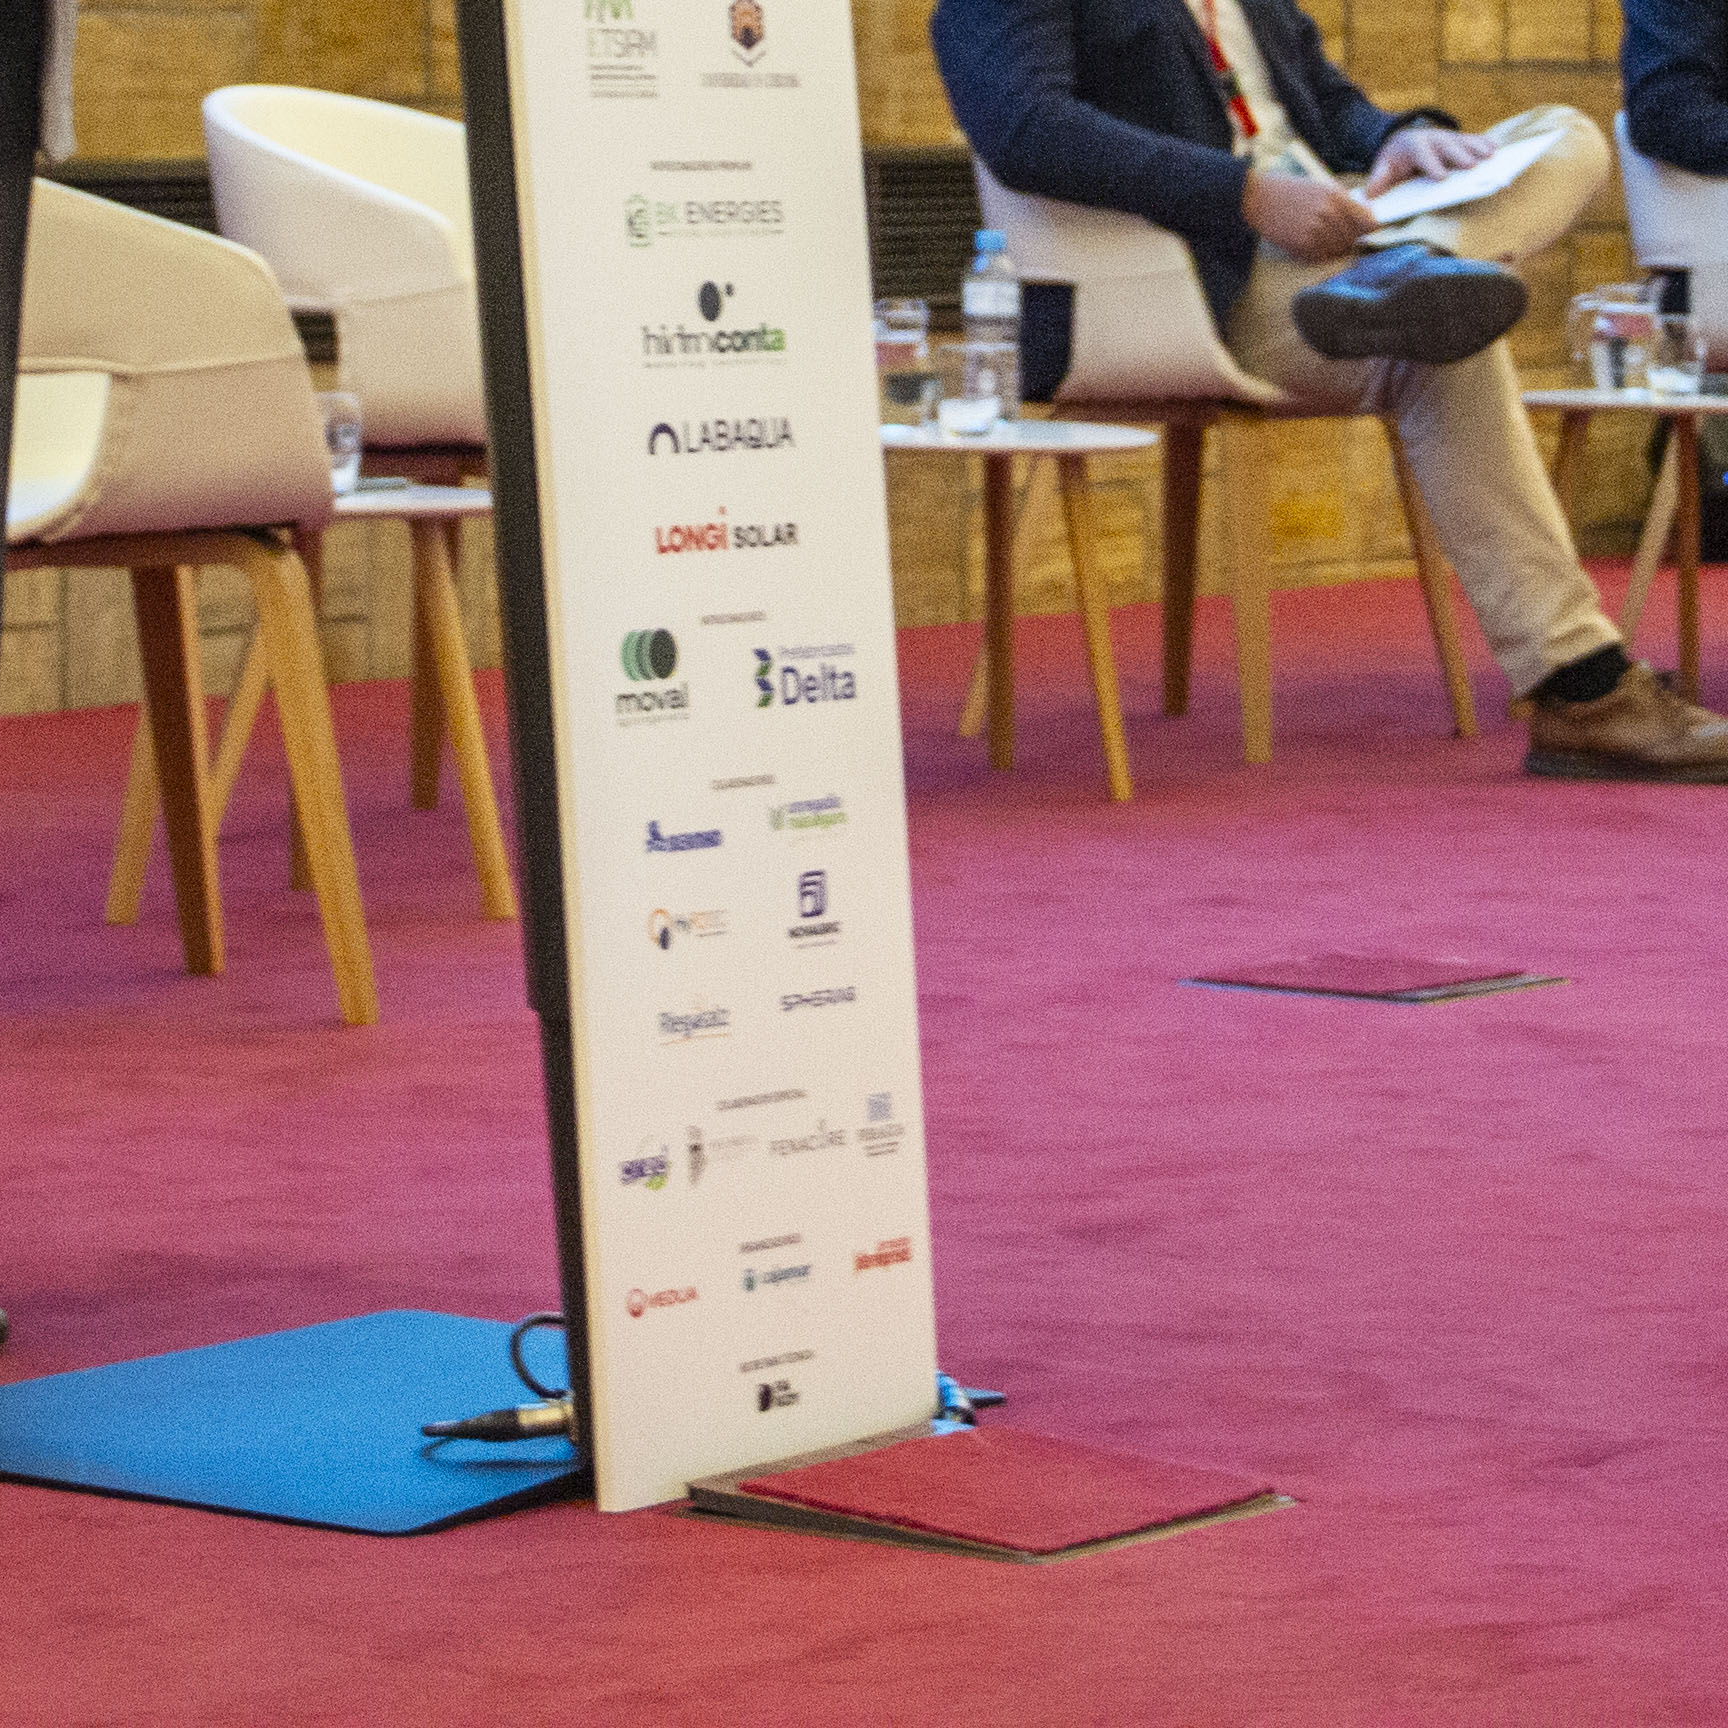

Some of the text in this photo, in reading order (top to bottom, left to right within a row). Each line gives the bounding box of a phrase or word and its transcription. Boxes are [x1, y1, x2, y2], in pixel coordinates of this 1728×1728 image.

[684, 199, 784, 225] ENERGIES
[682, 418, 796, 455] LABAQUA
[733, 522, 799, 550] SOLAR
[615, 680, 689, 714] moval
[780, 663, 857, 707] Delta
